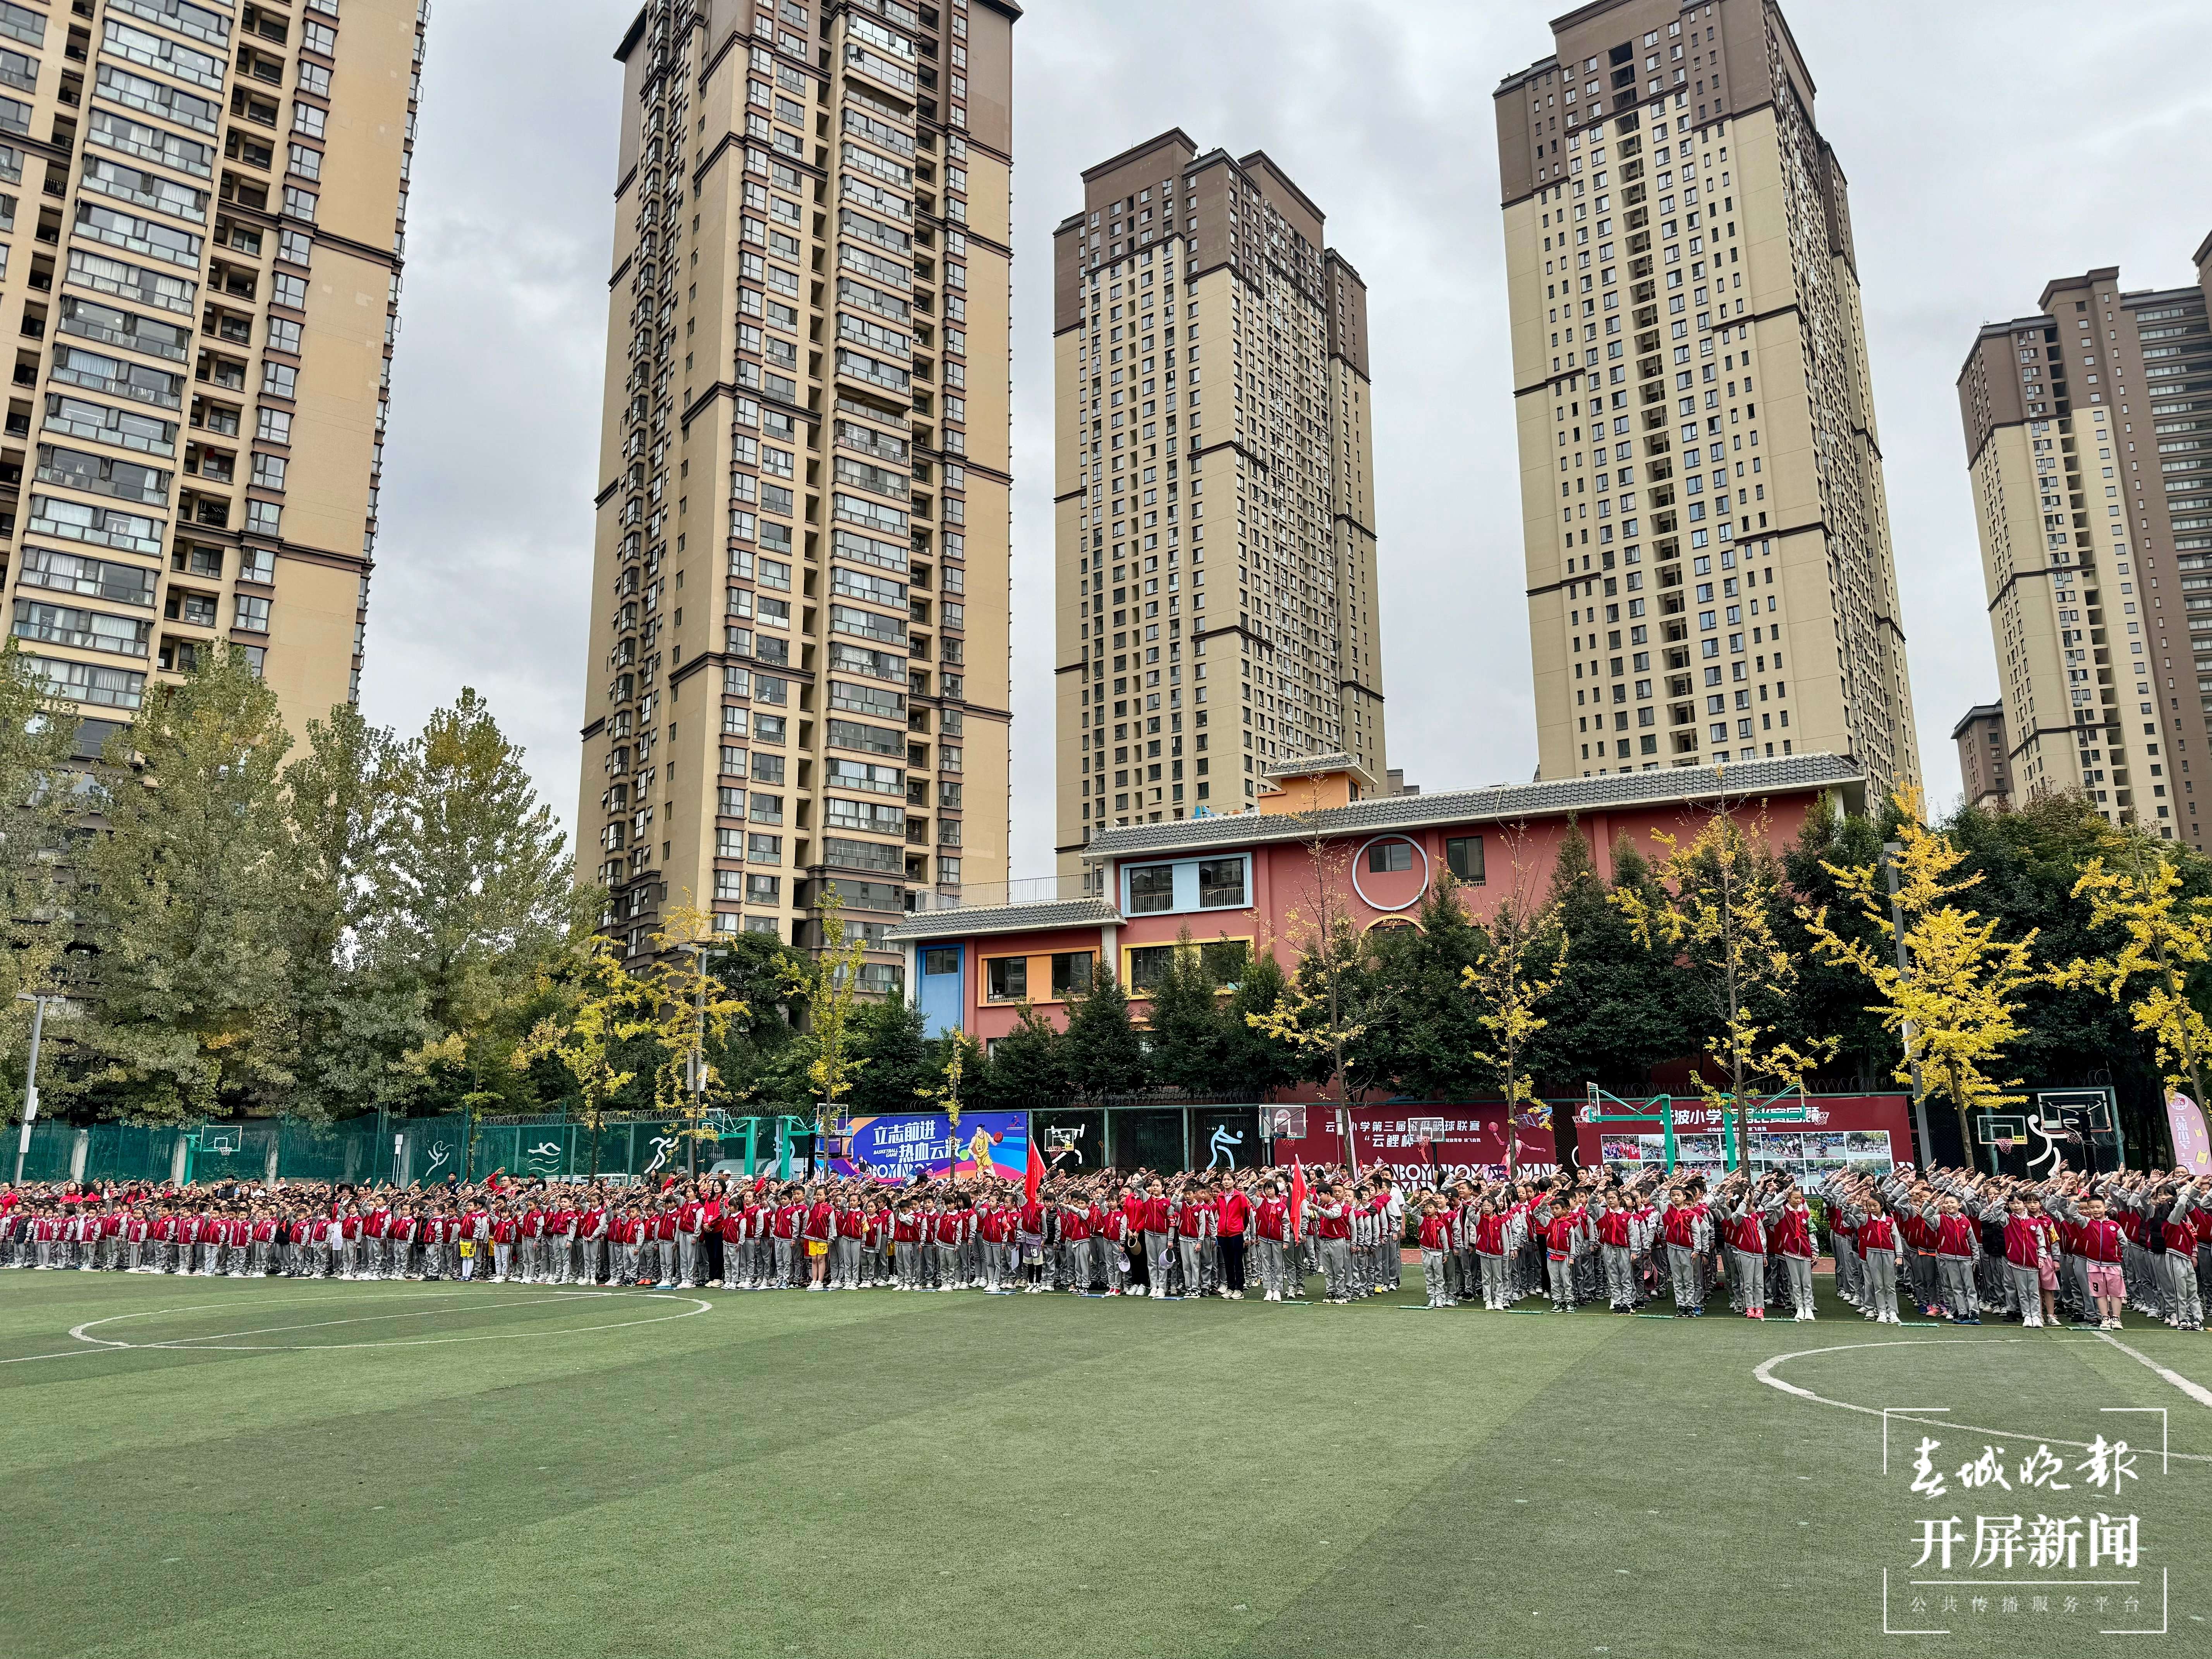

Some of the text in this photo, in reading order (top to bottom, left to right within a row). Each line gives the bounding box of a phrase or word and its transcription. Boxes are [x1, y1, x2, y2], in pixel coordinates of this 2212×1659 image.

[872, 1120, 936, 1146] 立志前进
[1325, 1120, 1480, 1132] 云小学第三届班级篮球联赛
[2174, 1113, 2191, 1149] 云波小学
[898, 1138, 960, 1164] 热血云波
[2092, 1282, 2099, 1293] 9
